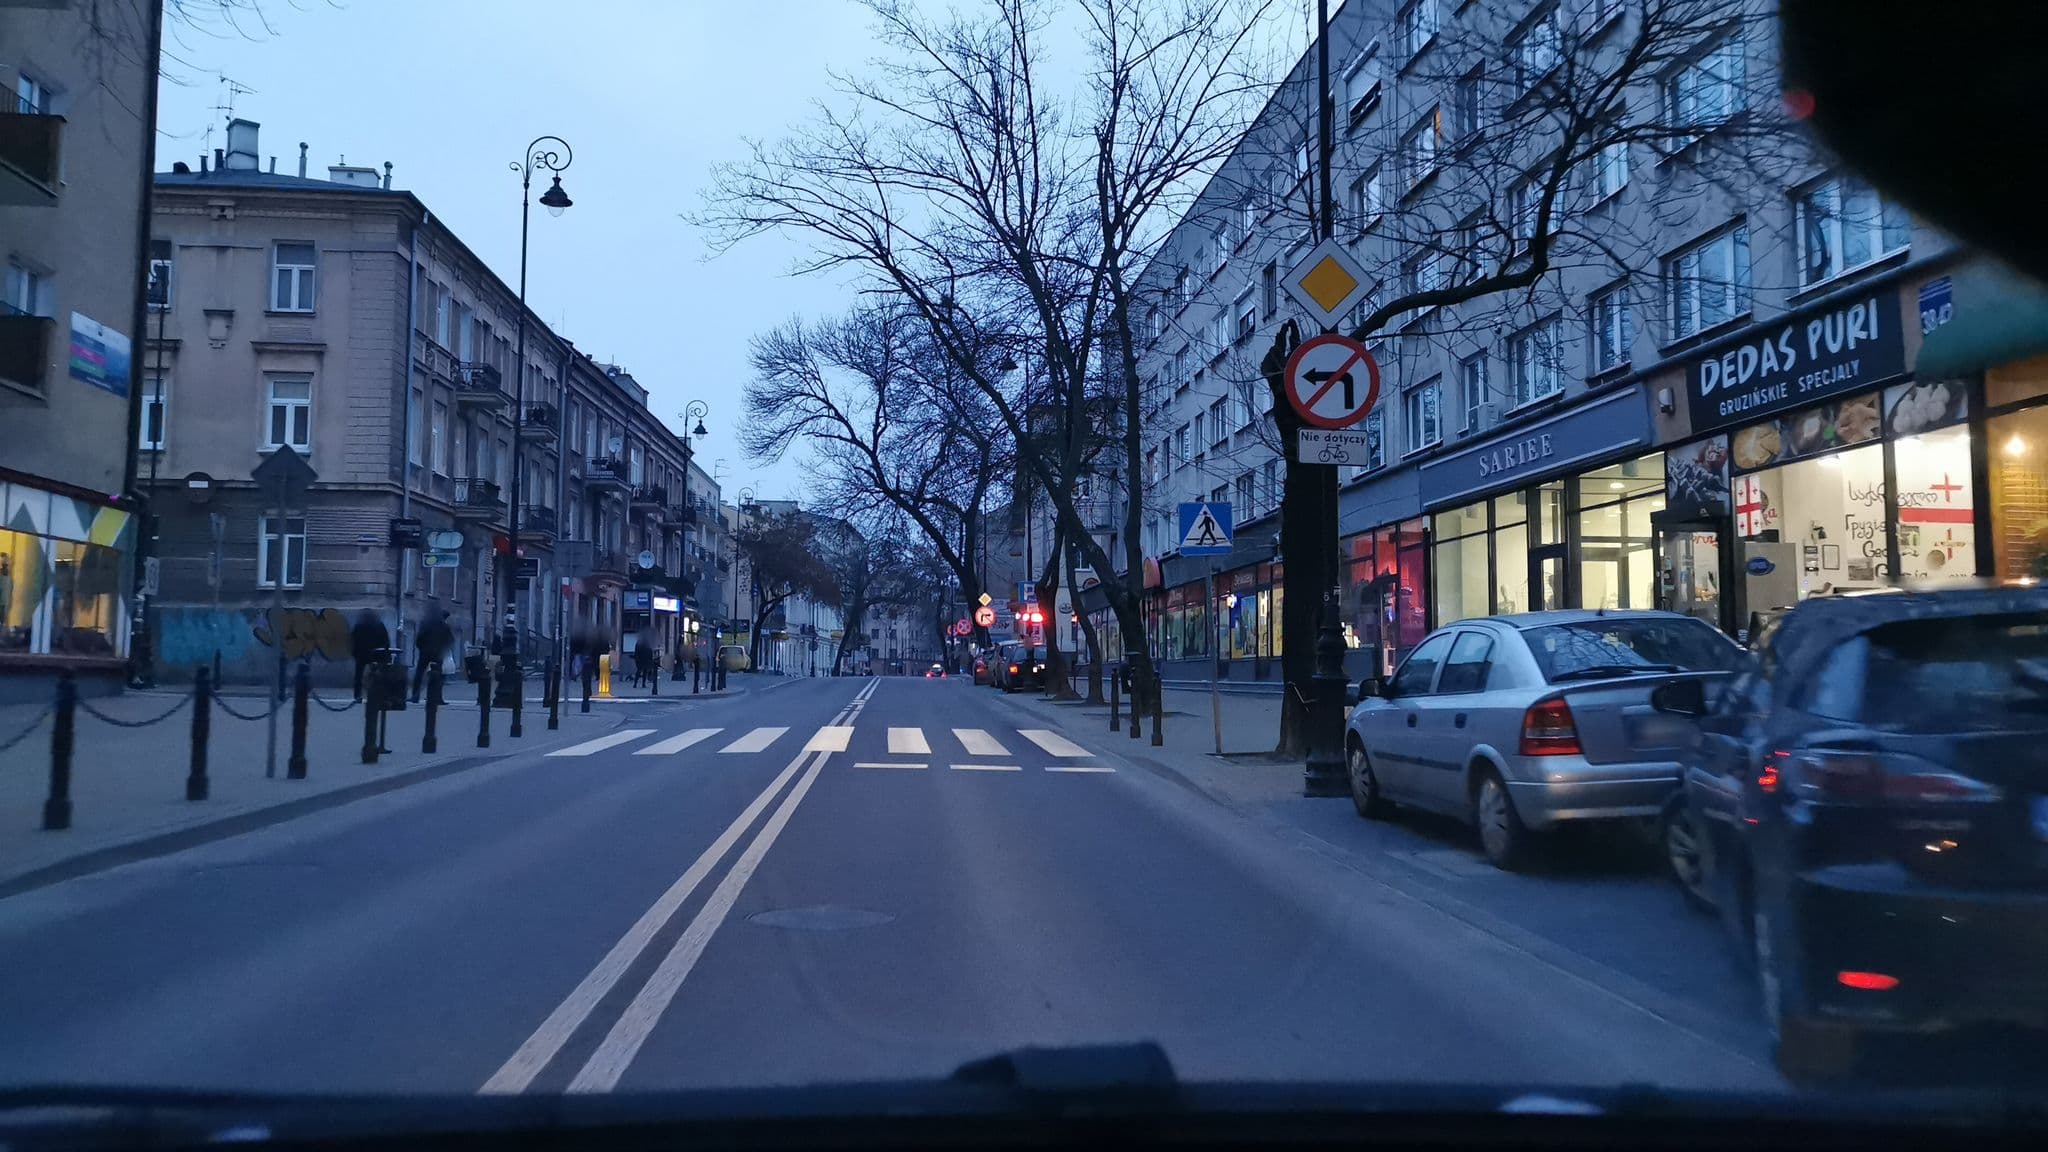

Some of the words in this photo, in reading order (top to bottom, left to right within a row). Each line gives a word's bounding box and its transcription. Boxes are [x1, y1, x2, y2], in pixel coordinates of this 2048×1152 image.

[1701, 326, 1796, 397] DEDAS
[1807, 298, 1879, 361] PURI
[1719, 382, 1788, 416] GRUZIŃSKIE
[1301, 431, 1320, 442] Nie
[1324, 433, 1366, 446] dotyczy
[1479, 433, 1553, 477] SARIEE
